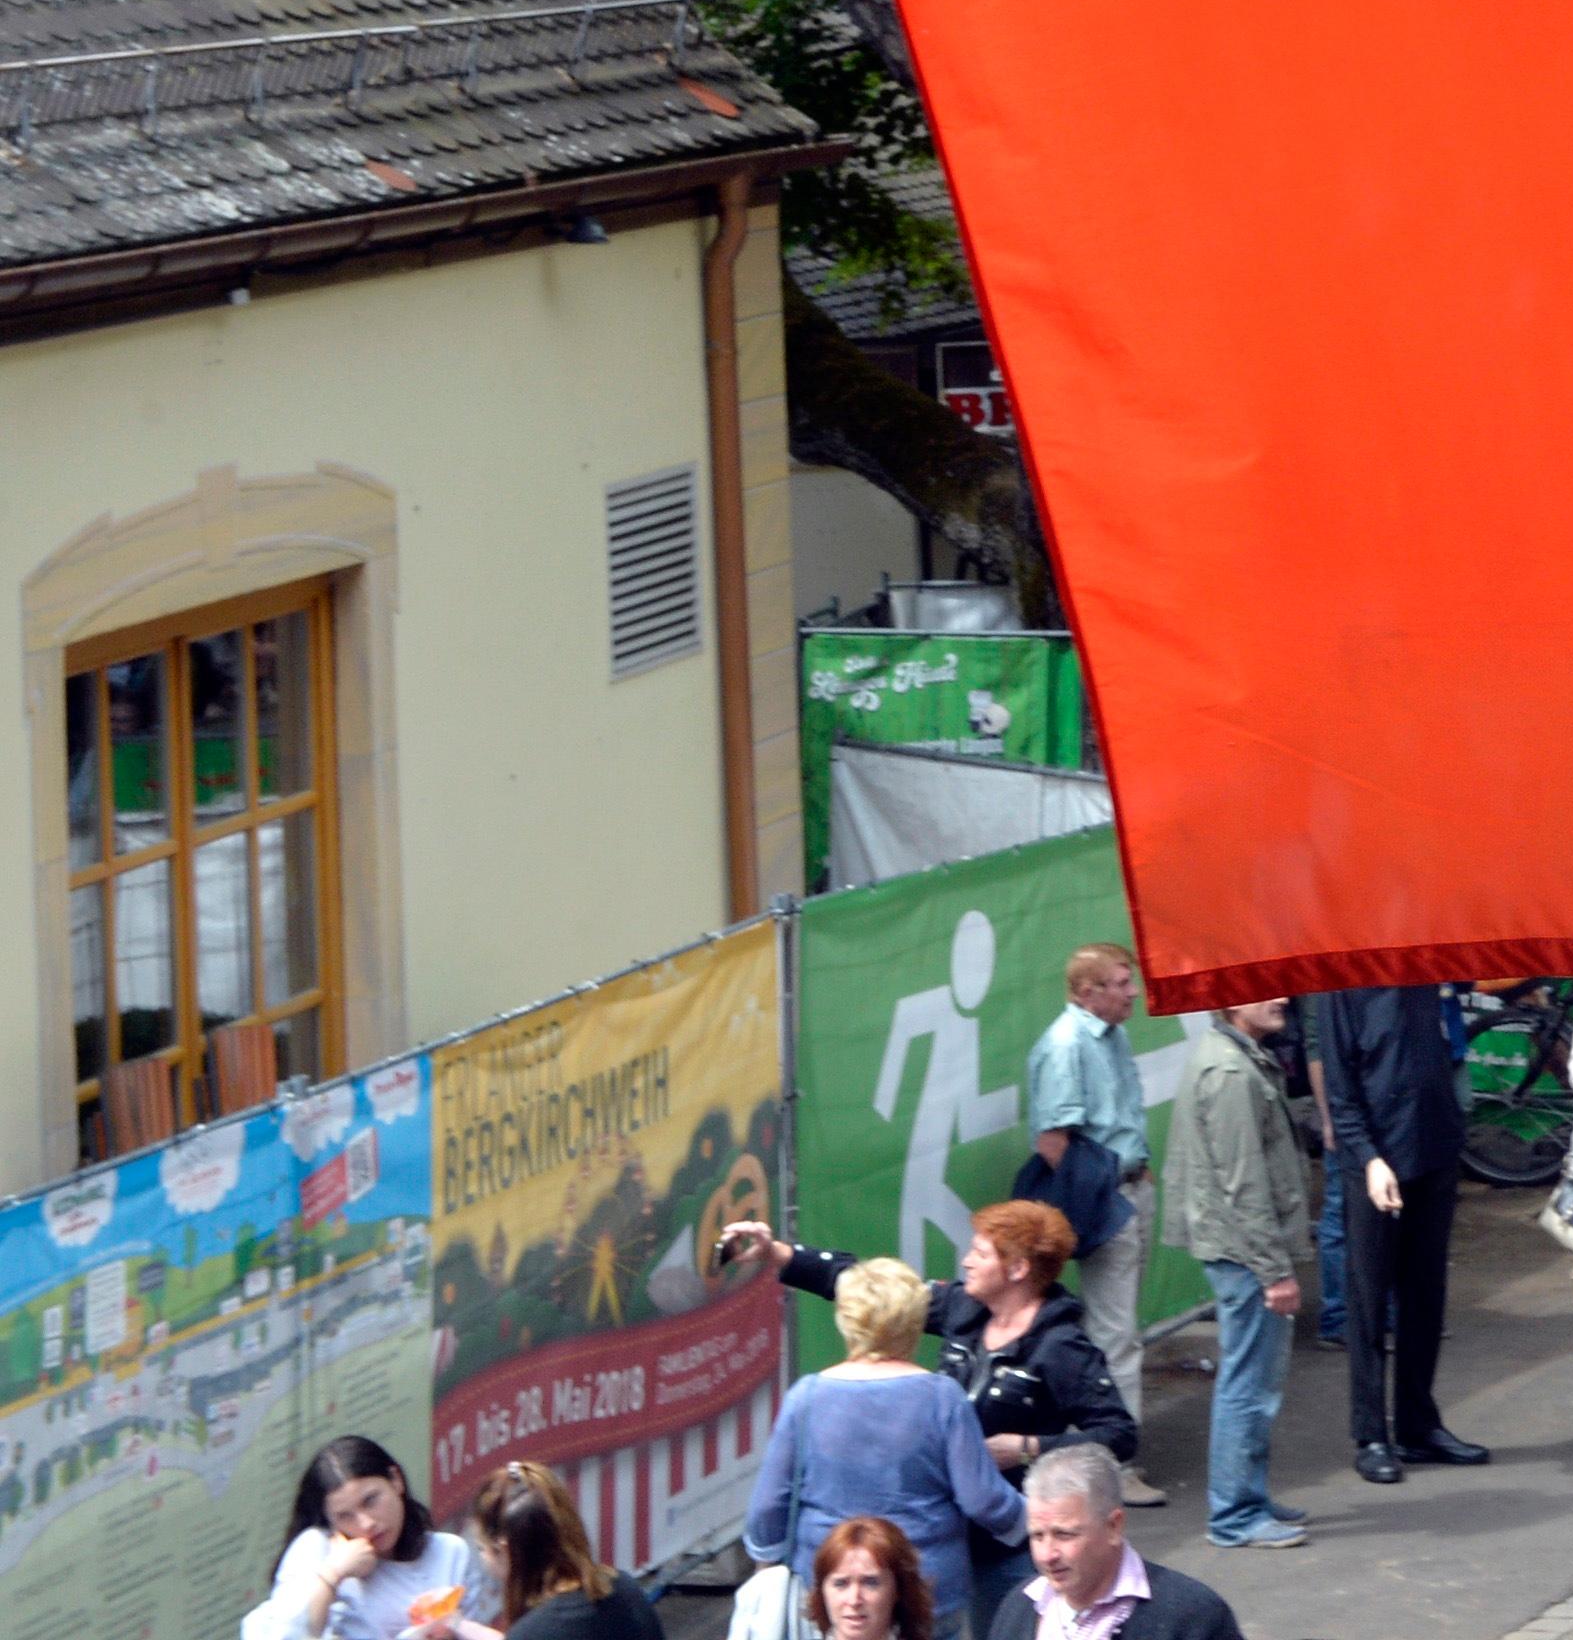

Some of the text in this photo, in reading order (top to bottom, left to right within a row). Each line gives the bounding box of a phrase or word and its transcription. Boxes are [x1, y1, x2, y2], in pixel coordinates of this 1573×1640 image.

[442, 1044, 672, 1216] BERGKIRCHWEIH
[436, 1365, 645, 1484] 17. bis 28. Mai 2018
